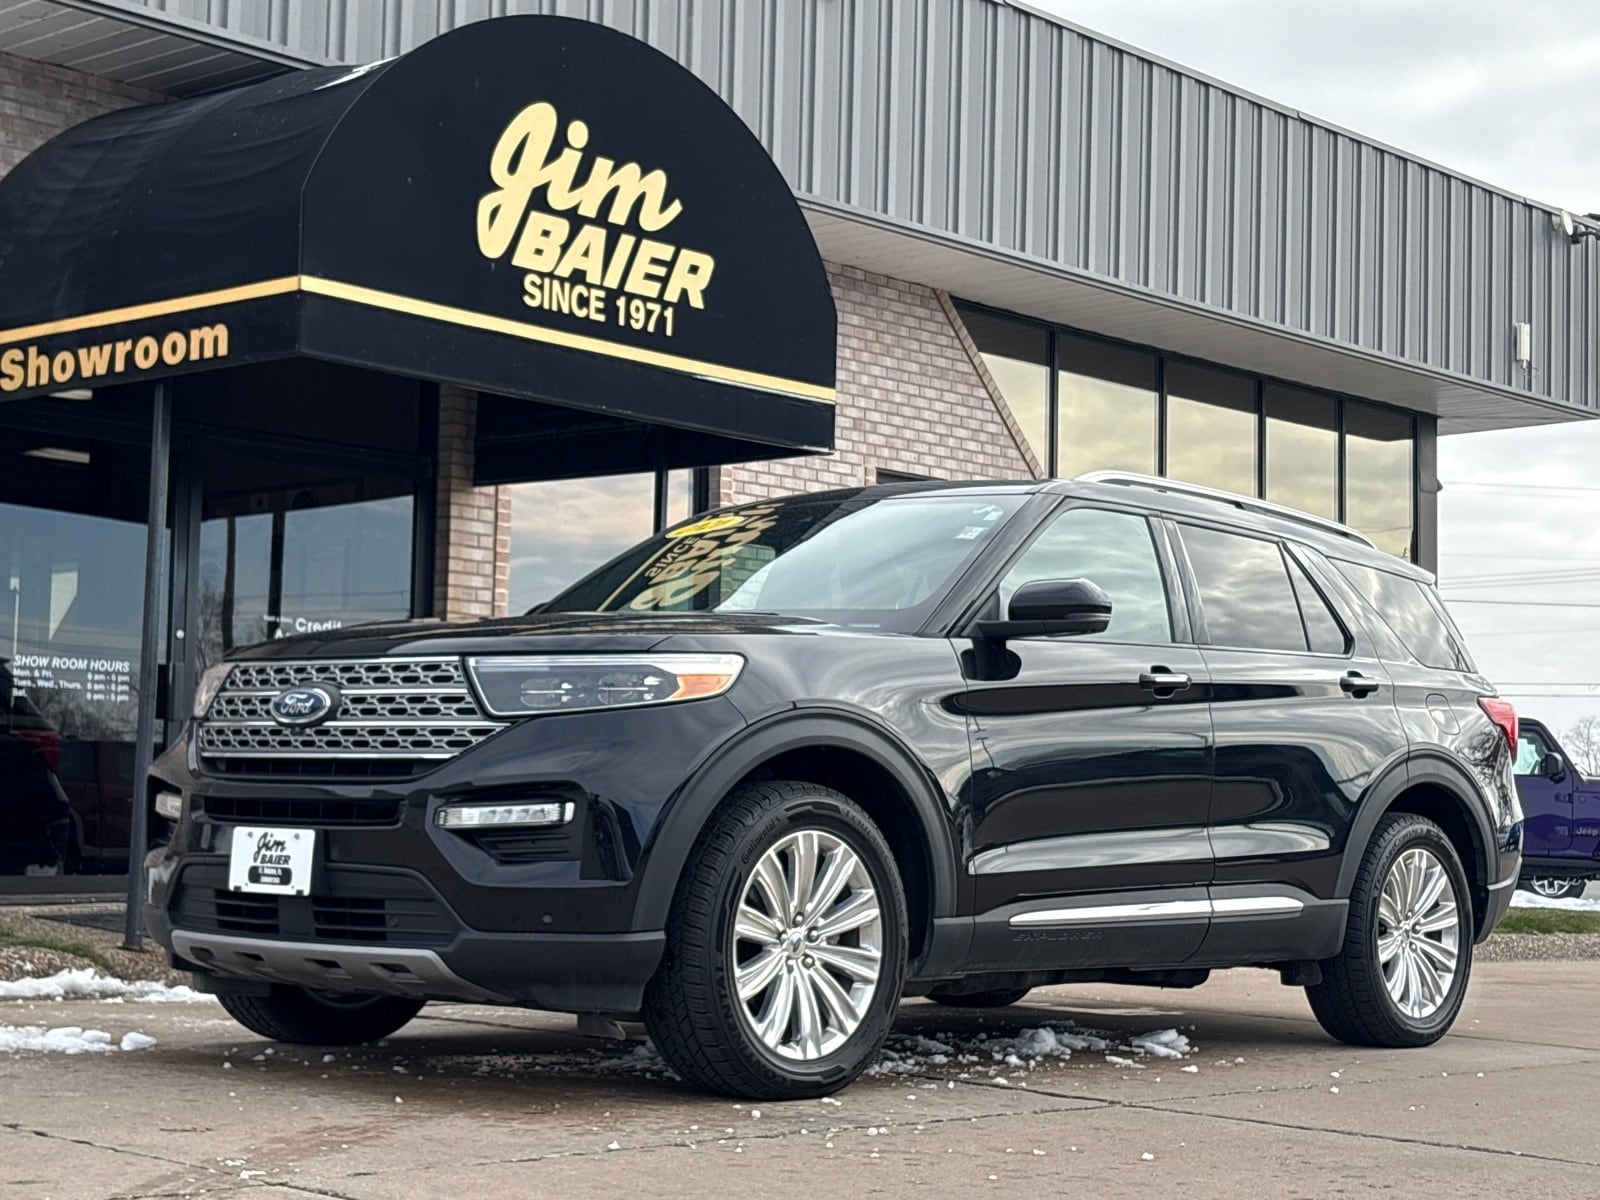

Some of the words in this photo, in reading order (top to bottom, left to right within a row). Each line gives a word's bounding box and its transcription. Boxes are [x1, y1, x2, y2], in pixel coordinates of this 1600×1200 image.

[477, 102, 683, 259] Jim
[511, 210, 715, 309] BAIER
[522, 273, 606, 322] SINCE
[616, 296, 674, 337] 1971
[0, 323, 229, 391] Showroom
[13, 654, 50, 668] SHOW
[51, 657, 88, 670] ROOM
[90, 660, 130, 673] HOURS
[280, 693, 314, 714] Ford
[1576, 826, 1598, 837] Jeep
[253, 832, 287, 863] Jim
[260, 854, 291, 866] BAIER
